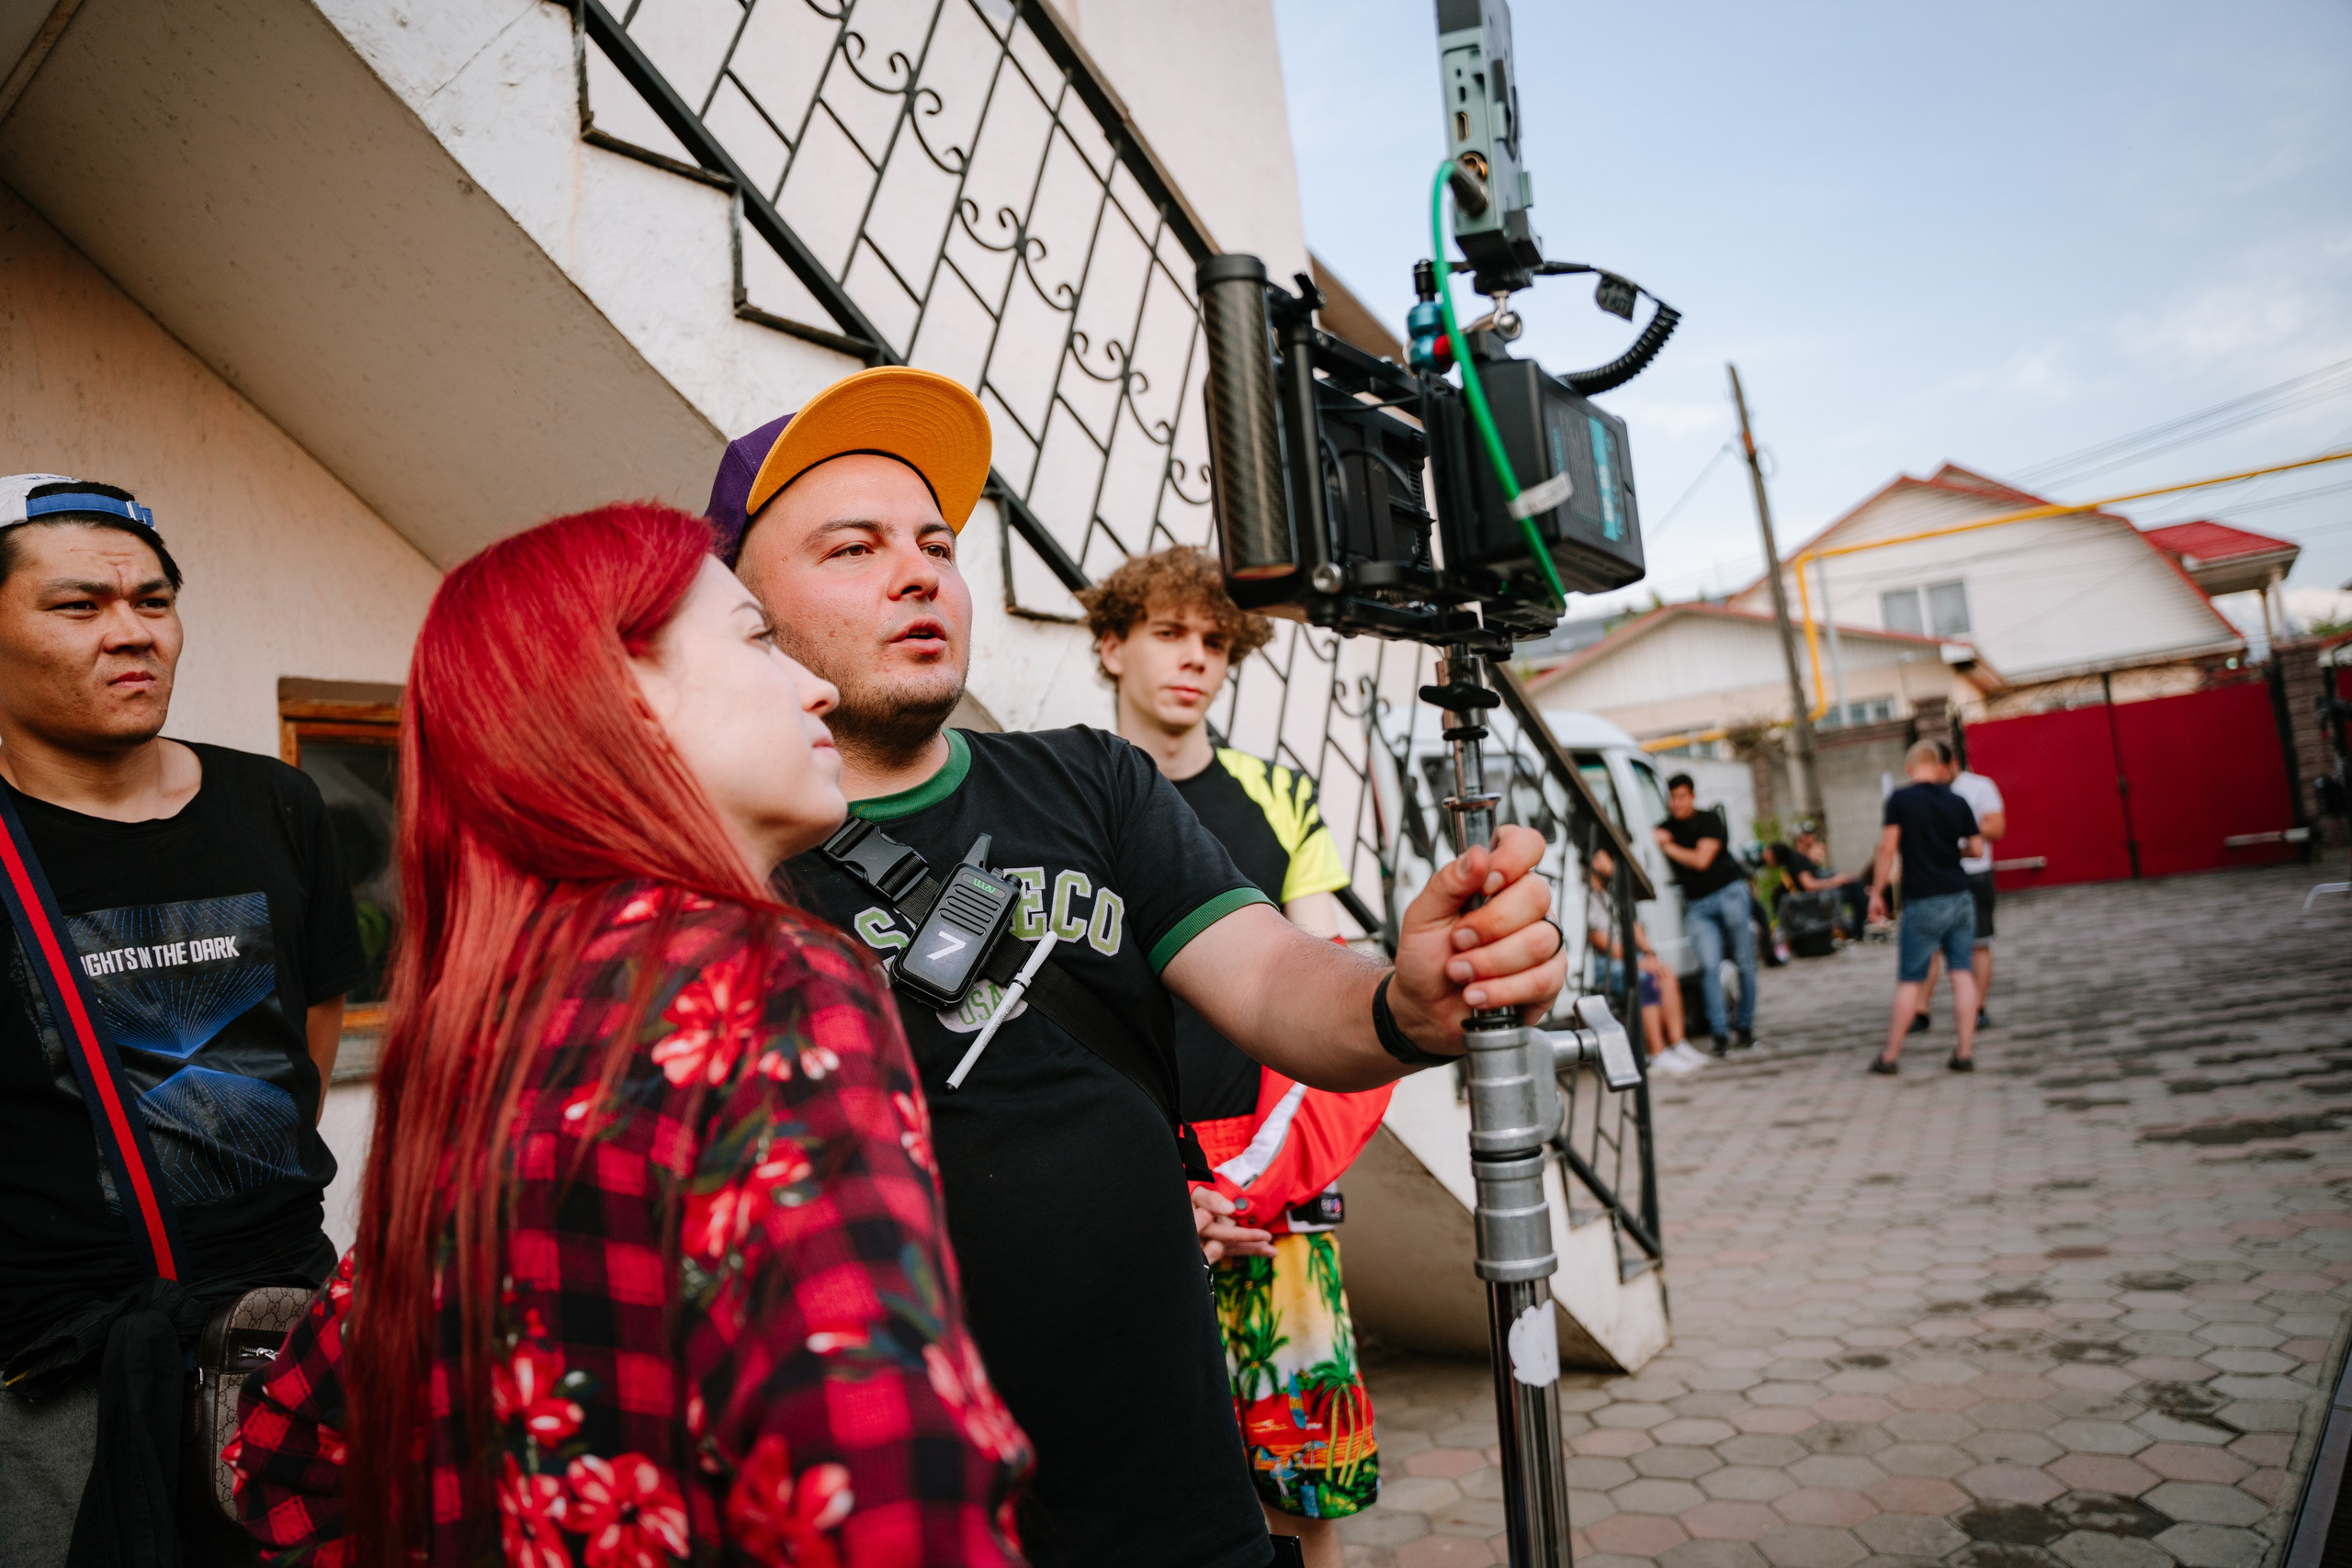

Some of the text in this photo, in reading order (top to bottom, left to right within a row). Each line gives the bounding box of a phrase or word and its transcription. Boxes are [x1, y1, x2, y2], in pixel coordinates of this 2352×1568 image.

[854, 866, 1125, 973] SECO
[80, 935, 241, 976] IGHTS IN THE DARK
[926, 930, 967, 961] 7
[957, 982, 1003, 1025] USA
